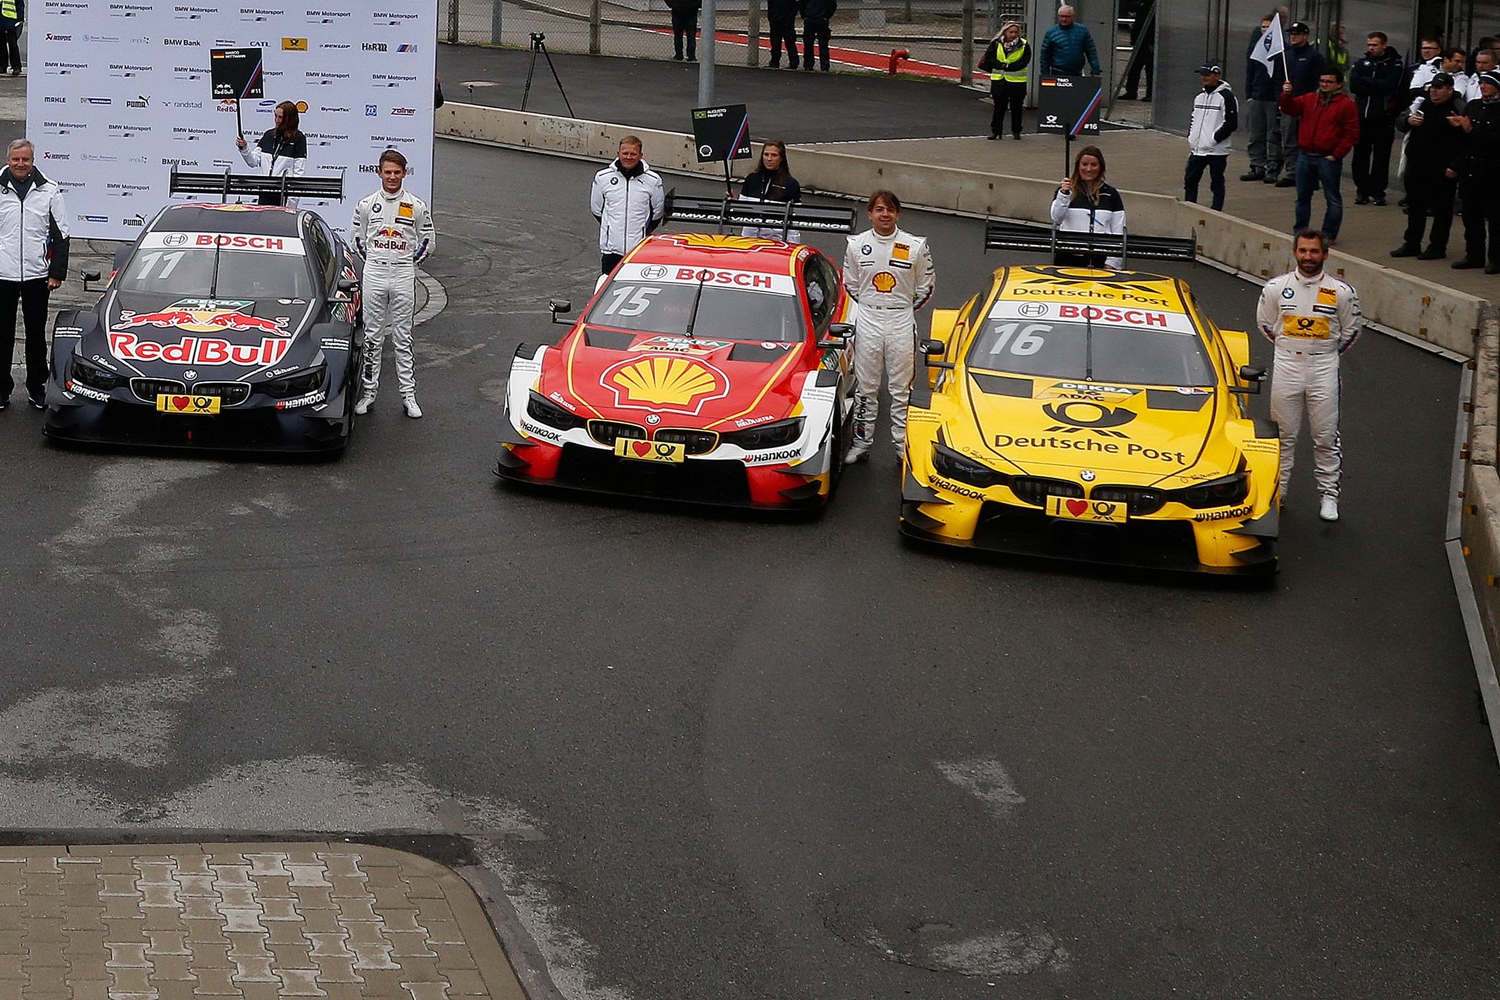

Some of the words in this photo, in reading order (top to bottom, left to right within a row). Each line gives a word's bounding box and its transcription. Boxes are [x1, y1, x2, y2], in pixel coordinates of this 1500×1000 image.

[163, 38, 182, 46] BMW
[126, 100, 146, 108] PUMA
[173, 101, 202, 109] randstad
[181, 159, 199, 167] Bank
[123, 218, 143, 226] PUMA
[196, 235, 283, 249] BOSCH
[374, 240, 390, 249] Red
[390, 241, 407, 250] Bull
[136, 251, 186, 279] 11
[676, 269, 771, 288] BOSCH
[604, 286, 662, 316] 15
[1013, 287, 1115, 299] Deutsche
[1122, 293, 1169, 307] Post
[1059, 305, 1167, 327] BOSCH
[989, 323, 1052, 356] 16
[109, 332, 195, 363] Red
[196, 338, 287, 364] Bull
[1062, 383, 1132, 394] DEKRA
[995, 435, 1118, 453] Deutsche
[1127, 443, 1185, 465] Post
